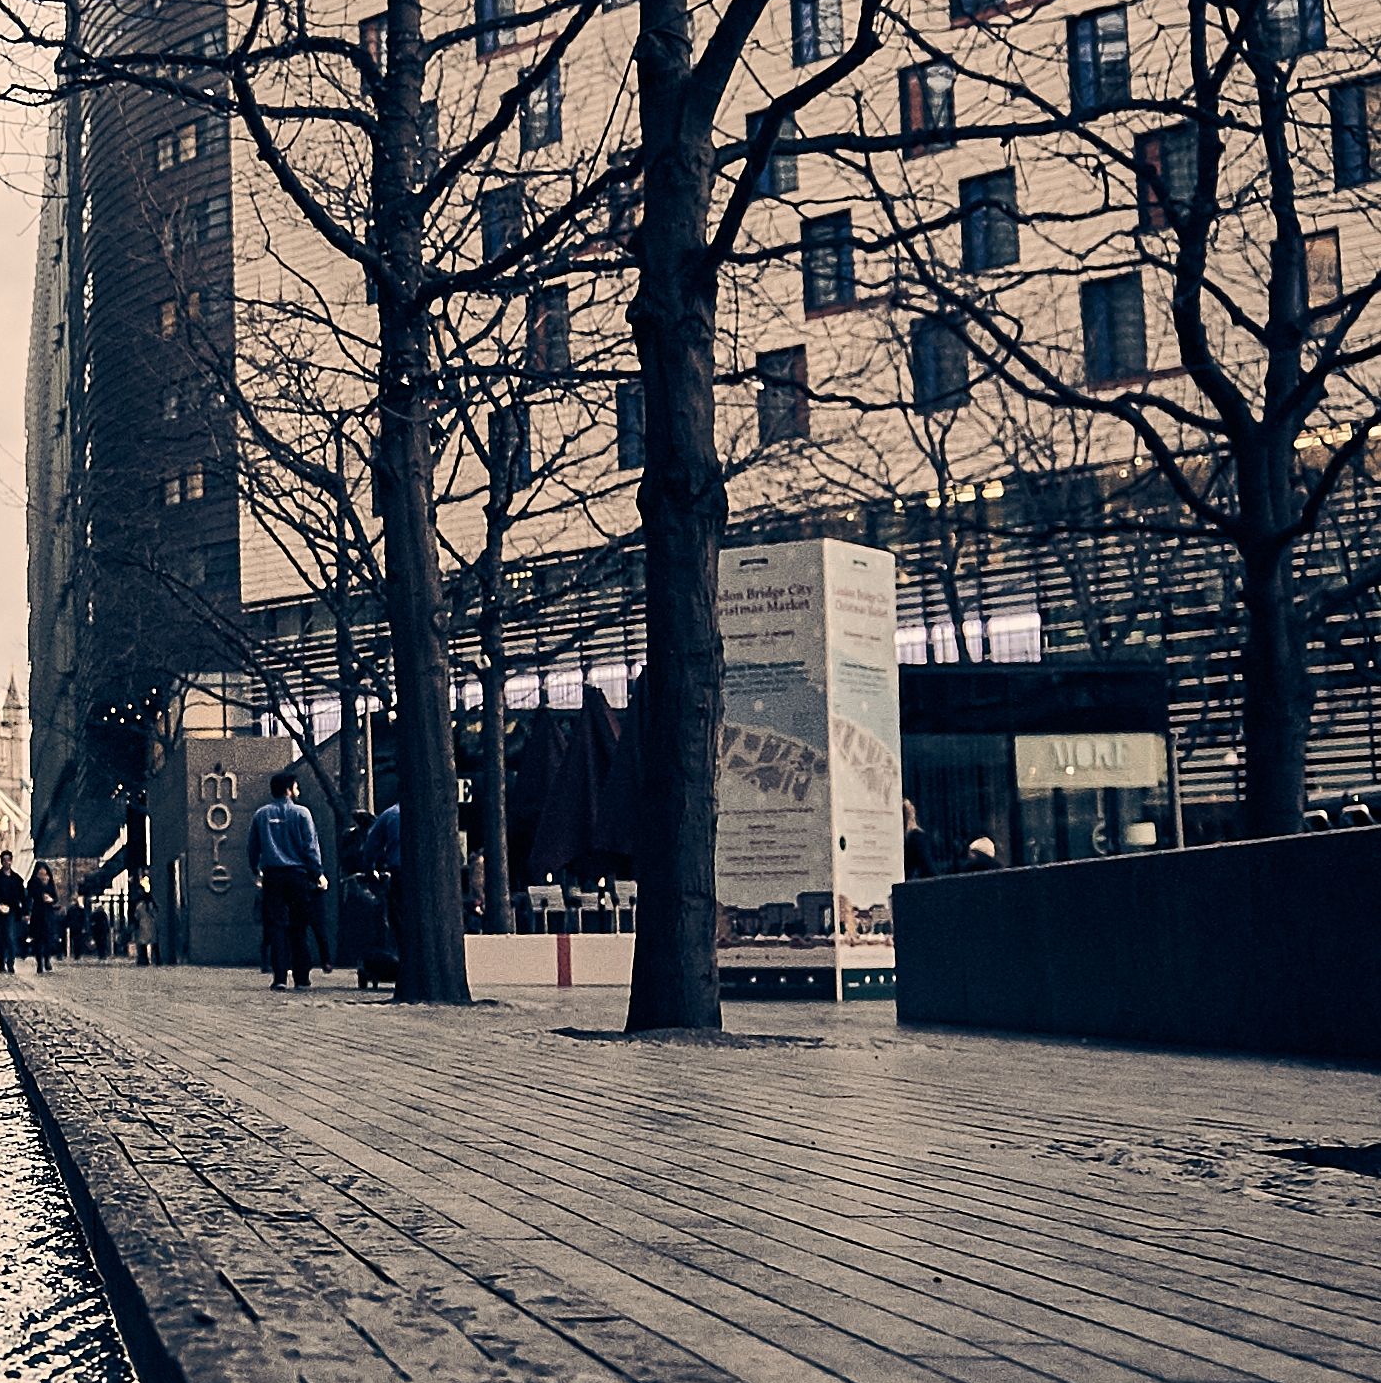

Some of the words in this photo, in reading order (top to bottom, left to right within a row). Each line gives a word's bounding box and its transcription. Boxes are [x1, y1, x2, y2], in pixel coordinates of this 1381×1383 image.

[746, 585, 786, 601] Bridge
[788, 583, 814, 598] City
[767, 598, 810, 613] Market
[200, 770, 238, 893] more
